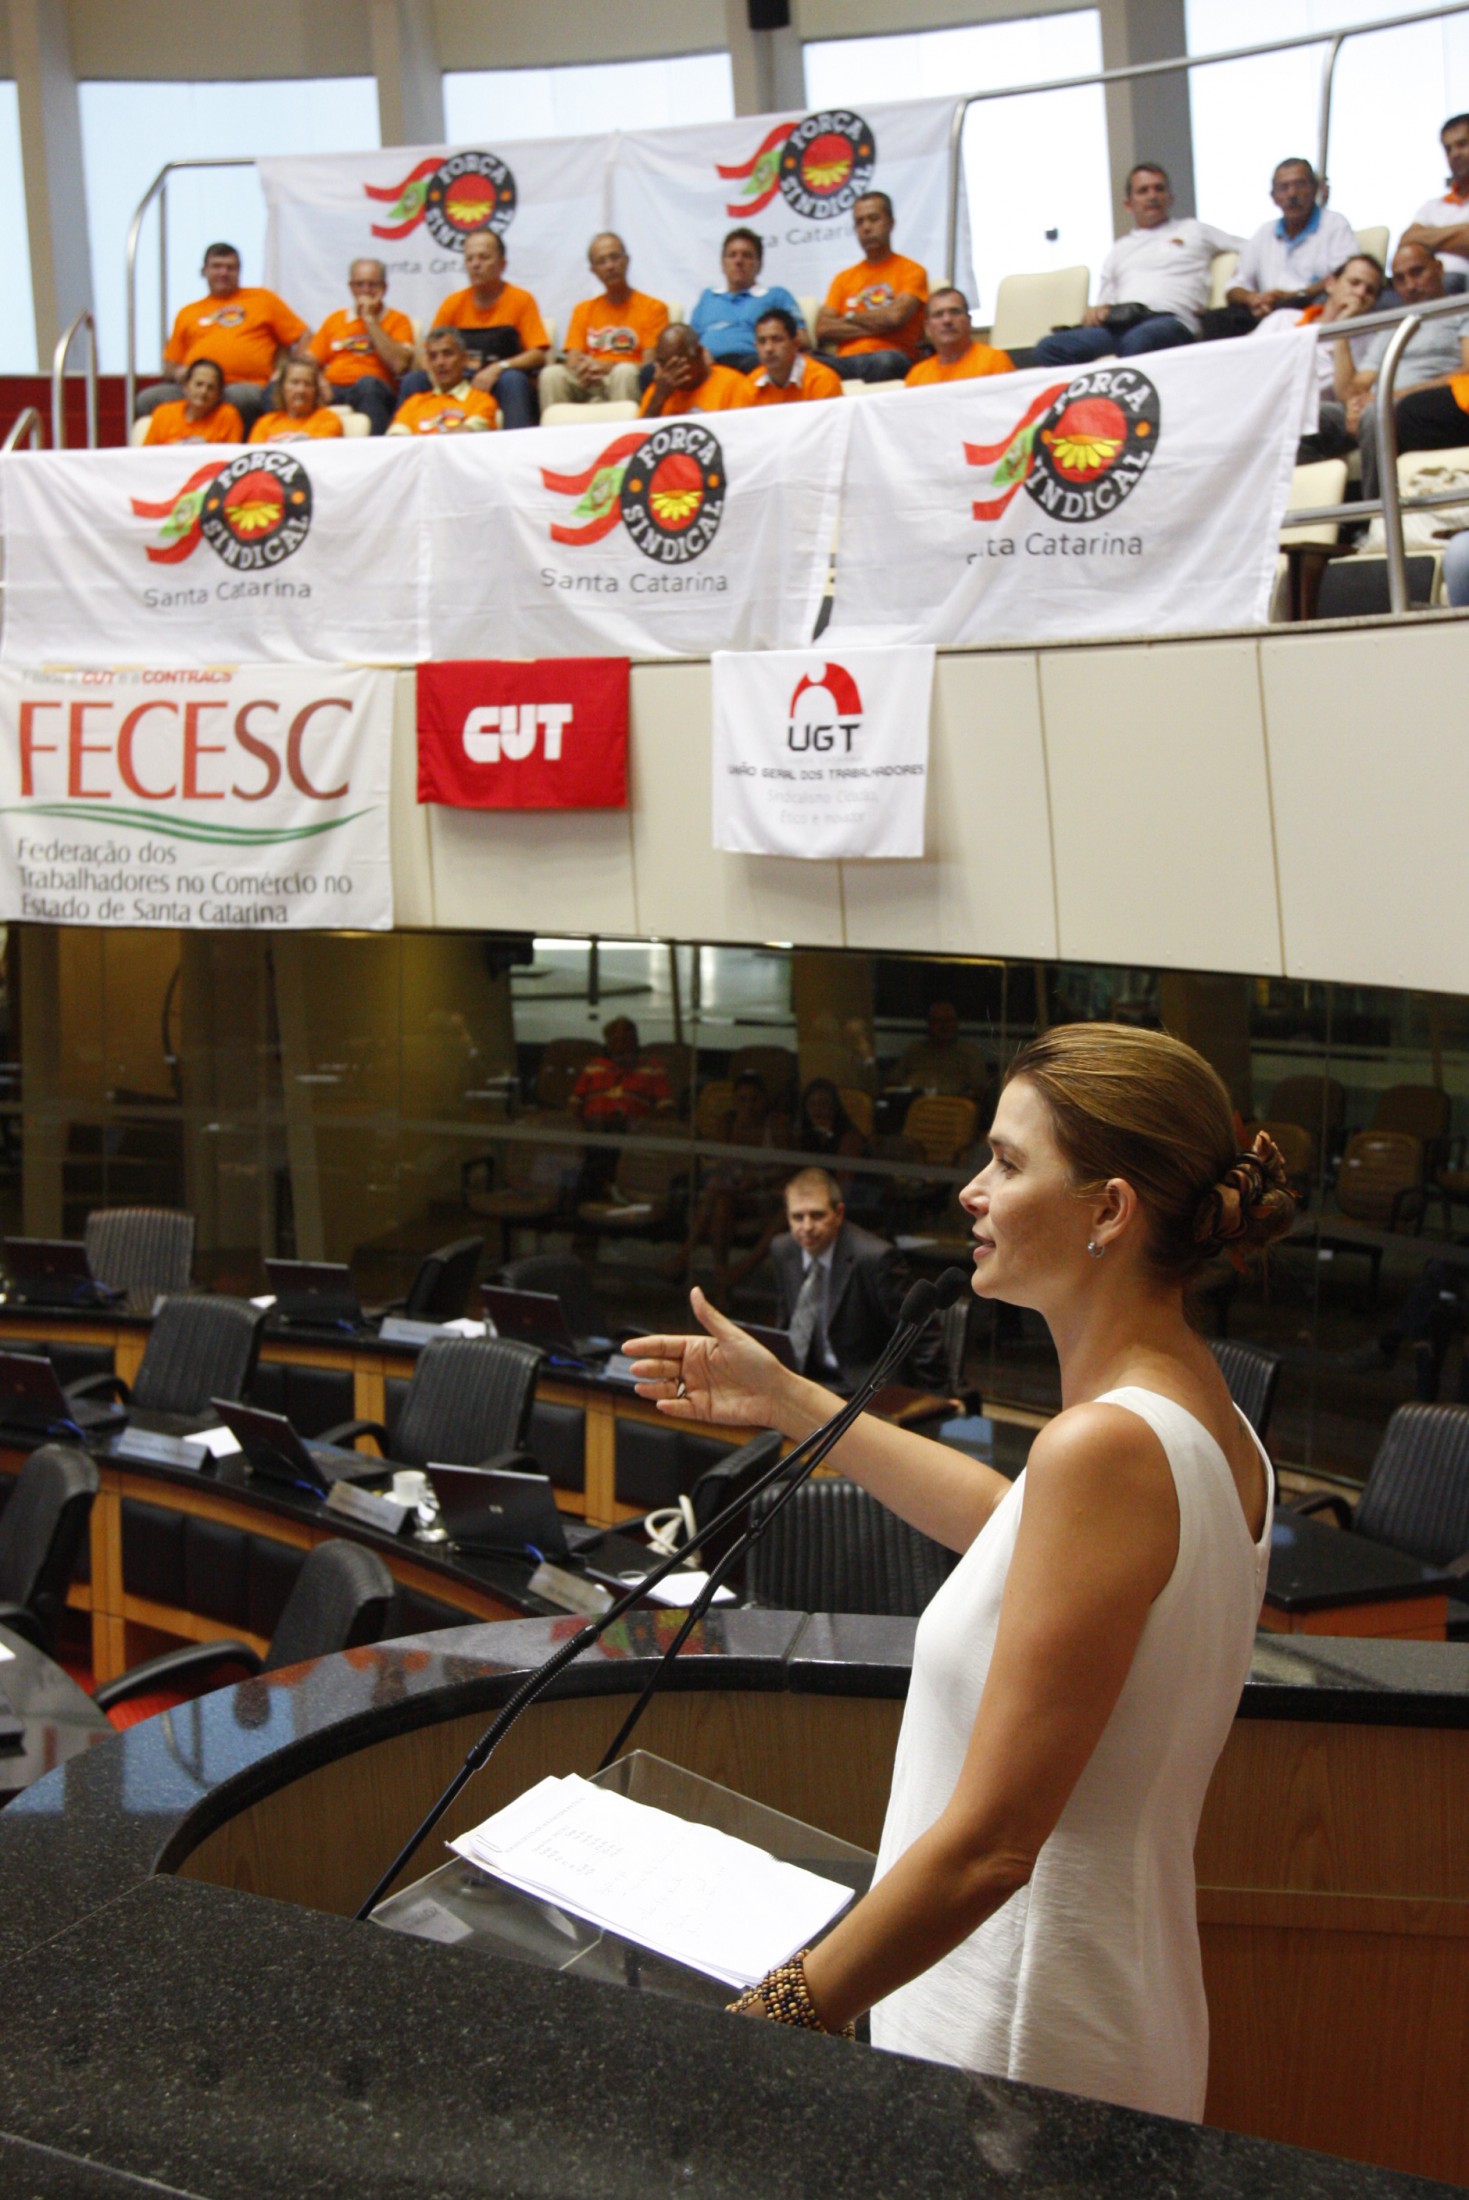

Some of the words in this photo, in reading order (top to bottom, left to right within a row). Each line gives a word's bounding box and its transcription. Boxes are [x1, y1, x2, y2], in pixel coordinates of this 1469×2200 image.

[790, 112, 864, 149] FORÇA
[437, 153, 508, 185] FORÇA
[637, 427, 718, 469] FORÇA
[218, 451, 300, 489] FORÇA
[203, 515, 310, 568] SINDICAL
[623, 500, 723, 561] SINDICAL
[1025, 532, 1143, 556] Catarina
[144, 588, 208, 608] Santa
[216, 578, 312, 601] Catarina
[540, 567, 619, 593] Santa
[629, 571, 729, 593] Catarina
[462, 703, 573, 763] CUT
[788, 722, 862, 753] UGT
[18, 697, 354, 801] FECESC
[801, 769, 823, 780] DOS
[18, 838, 131, 867] Federação
[138, 840, 177, 864] dos
[18, 865, 170, 894] Trabalhadores
[177, 875, 205, 893] no
[211, 871, 317, 895] Comércio
[325, 874, 353, 893] no
[22, 893, 90, 919] Estado
[97, 897, 125, 919] de
[133, 898, 192, 922] Santa
[199, 900, 288, 924] Catarina
